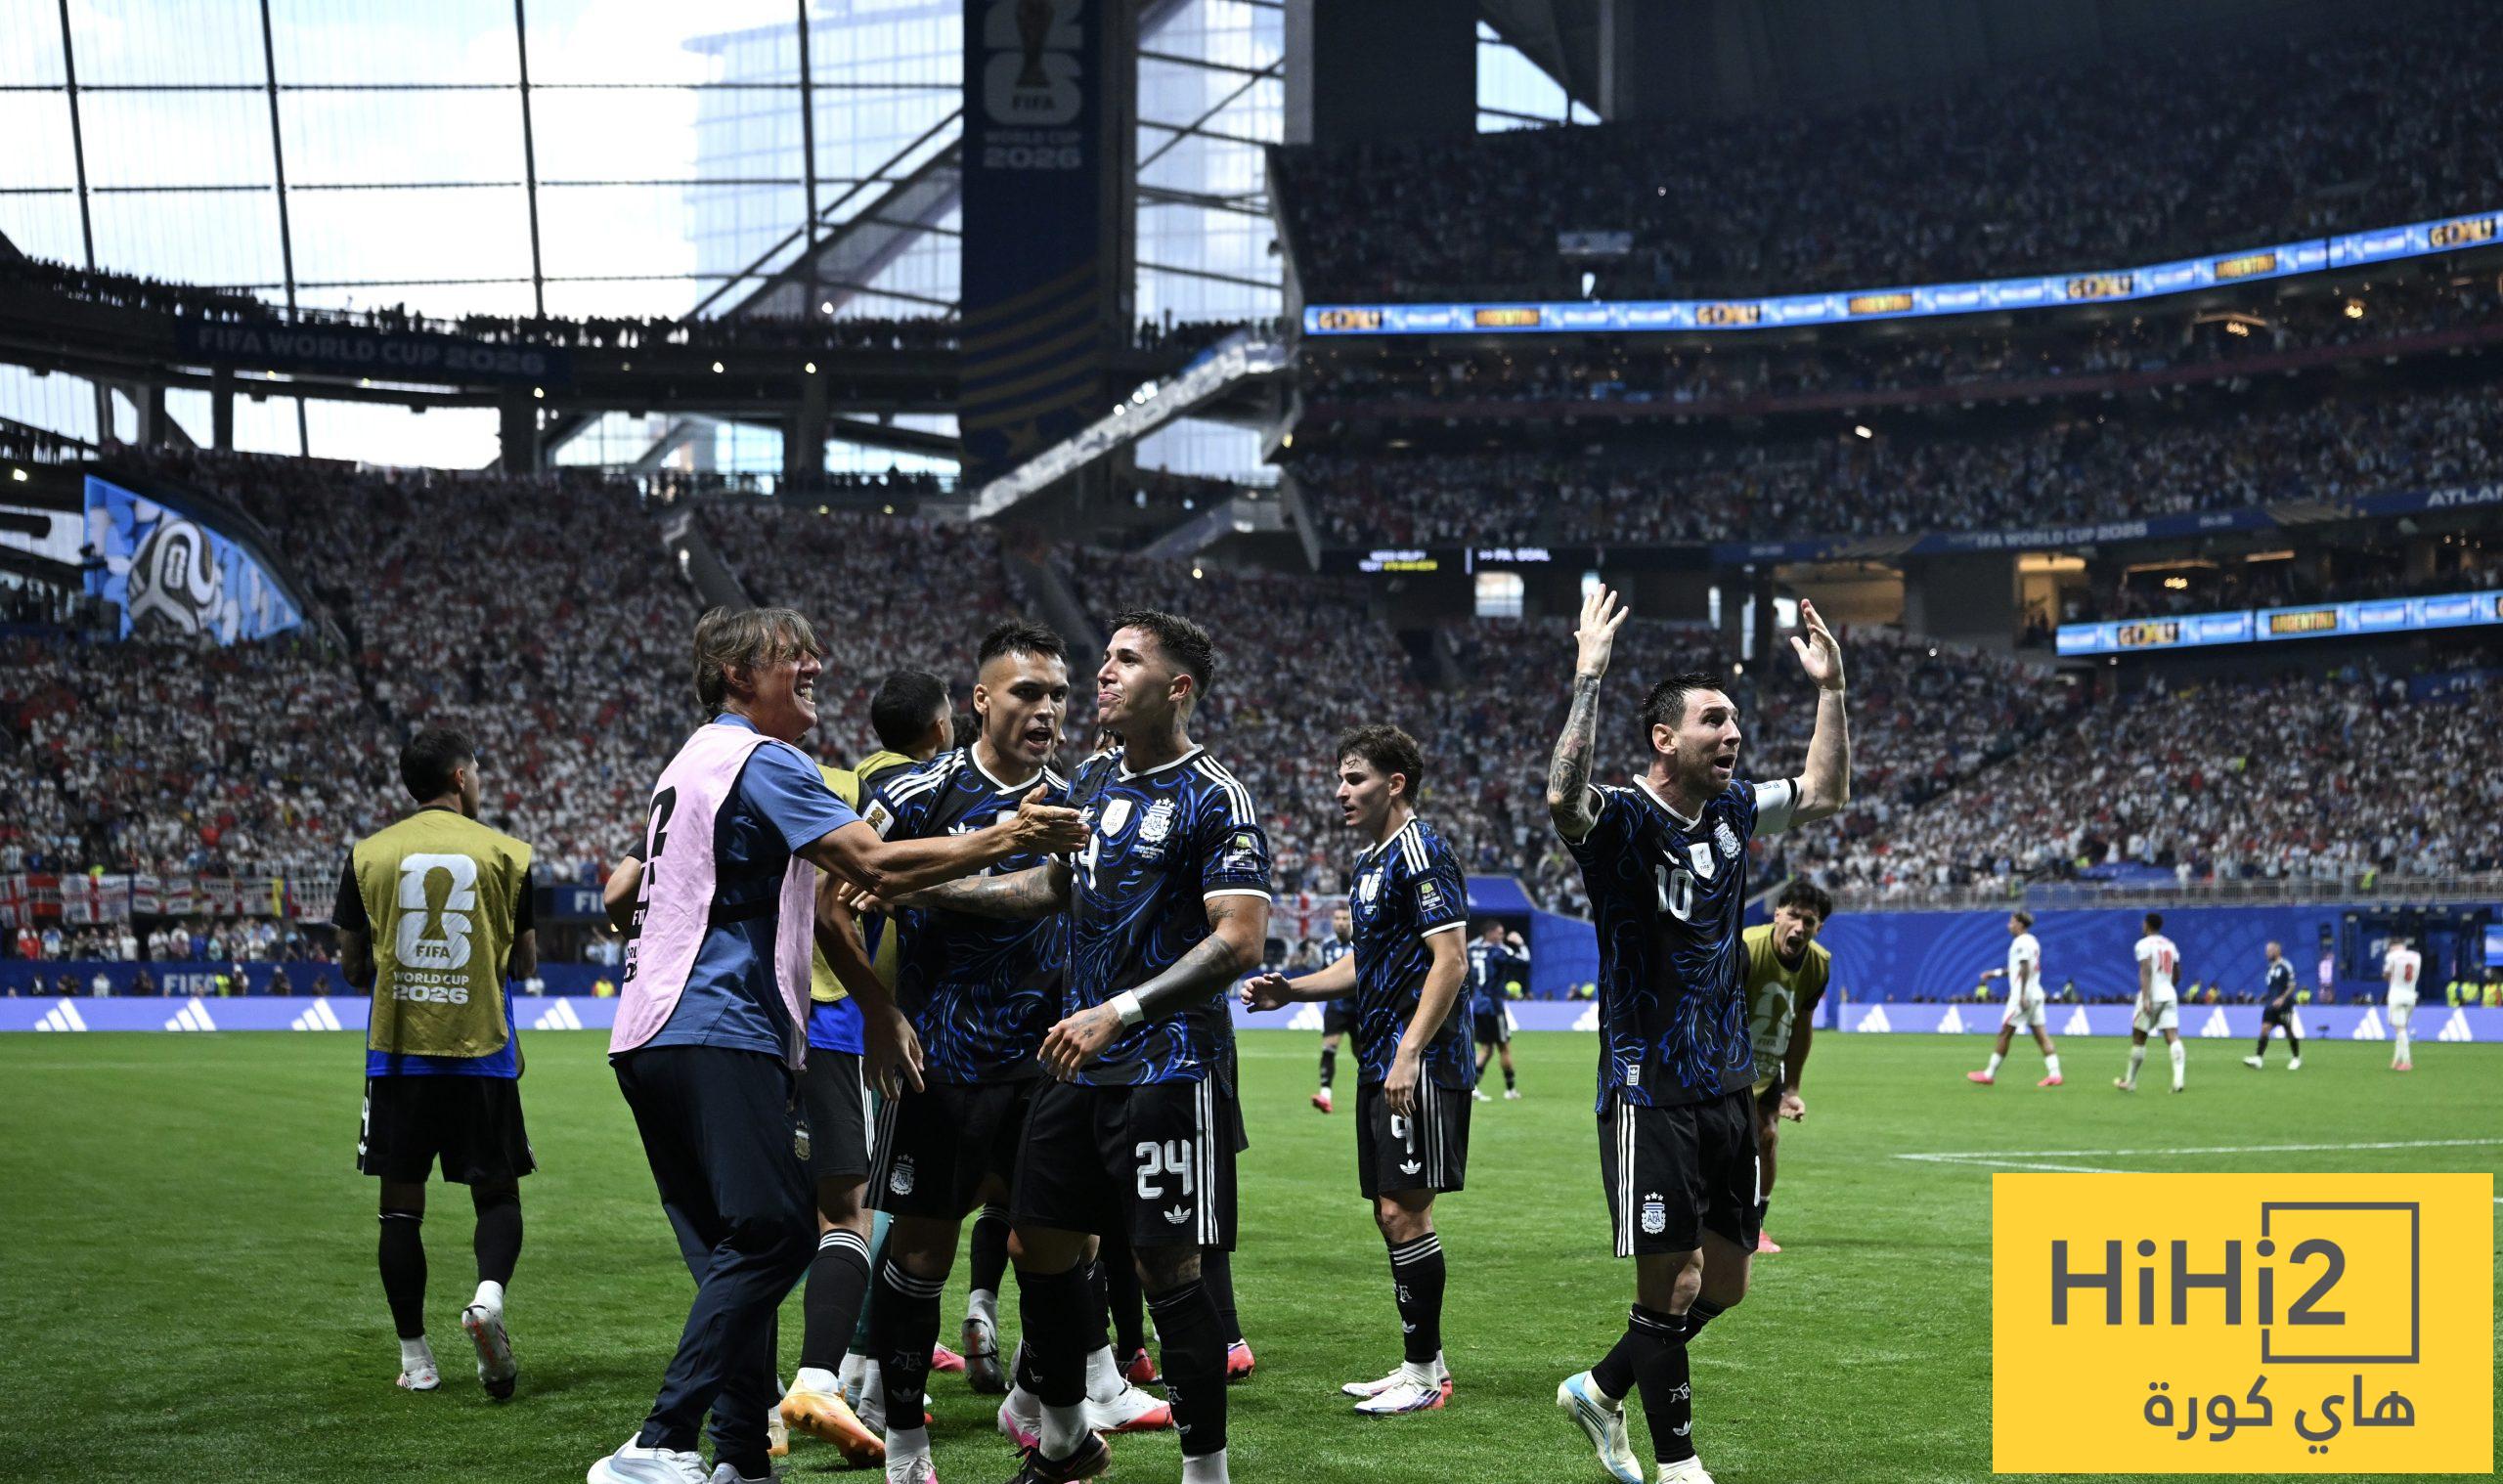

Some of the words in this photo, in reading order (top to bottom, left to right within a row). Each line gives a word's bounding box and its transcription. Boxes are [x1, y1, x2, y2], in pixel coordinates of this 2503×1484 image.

[983, 147, 1082, 169] 2026
[198, 327, 263, 354] FIFA
[268, 332, 376, 362] WORLD
[380, 340, 440, 367] CUP
[444, 348, 547, 375] 2026
[2005, 531, 2064, 546] WORLD
[2096, 521, 2147, 542] 2026
[1655, 863, 1693, 922] 10
[416, 944, 451, 959] FIFA
[163, 974, 216, 994] FIFA
[394, 971, 440, 984] WORLD
[442, 974, 469, 986] CUP
[1472, 959, 1486, 986] 7
[393, 984, 469, 1005] 2026
[1390, 1113, 1415, 1155] 9
[1135, 1139, 1194, 1200] 24
